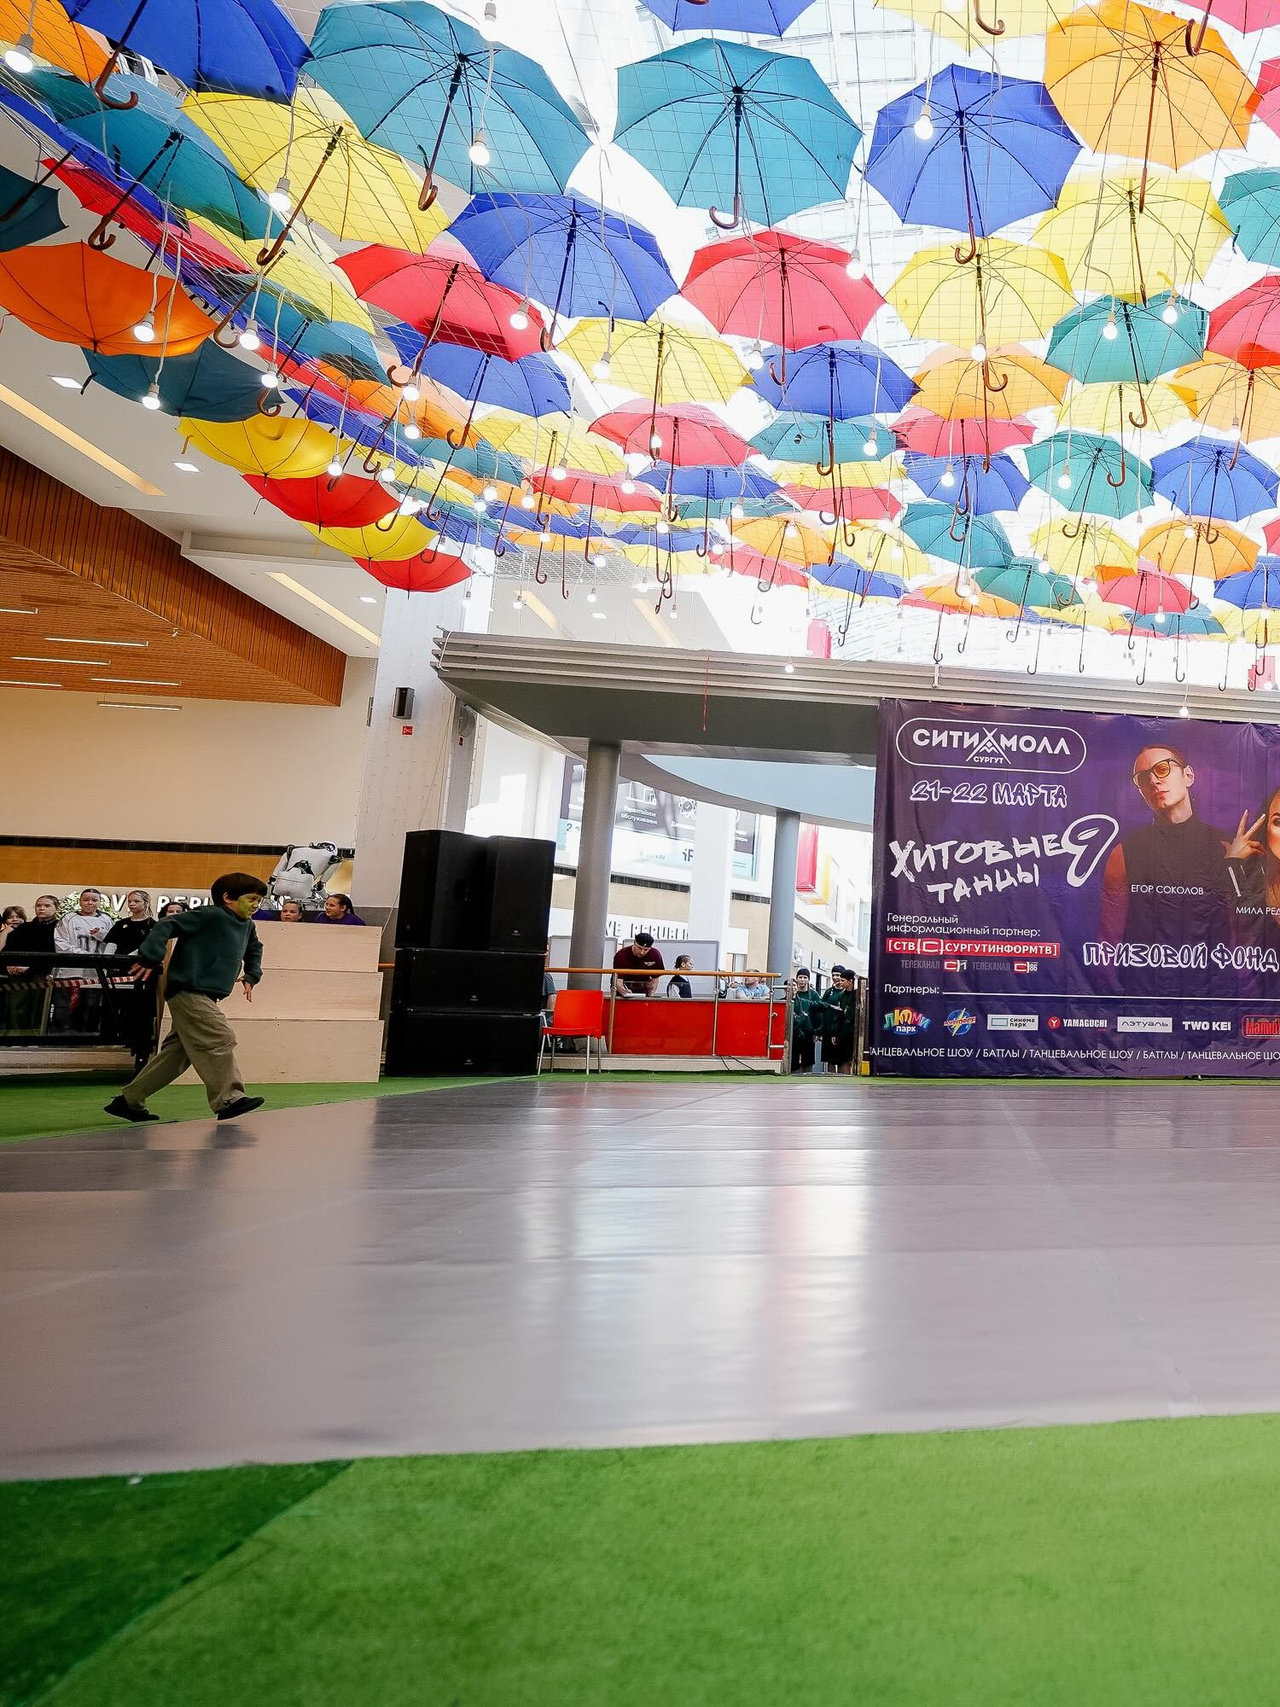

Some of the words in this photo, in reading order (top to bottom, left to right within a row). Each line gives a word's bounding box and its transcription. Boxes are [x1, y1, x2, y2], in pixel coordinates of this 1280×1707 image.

[973, 756, 1004, 764] СУРГУТ
[910, 780, 988, 804] 21-22
[992, 782, 1068, 808] МАРТА
[927, 863, 1040, 904] ТАНЦЫ
[1131, 885, 1153, 893] ЕГОР
[1155, 885, 1204, 895] СОКОЛОВ
[1235, 907, 1263, 915] МИЛА
[887, 913, 959, 924] Генеральный
[630, 923, 689, 940] REPUBLI
[886, 923, 990, 935] информационный
[992, 928, 1041, 938] партнер:
[1083, 941, 1208, 969] ПРИЗОВОЙ
[1211, 943, 1279, 973] ФОНД
[901, 959, 940, 969] ТЕЛЕКАНАЛ
[884, 984, 940, 995] Партнеры:
[883, 1006, 932, 1030] ЛЮМИ
[1063, 1018, 1108, 1028] YAMAGUCHI
[895, 1025, 916, 1034] парк
[1182, 1021, 1209, 1031] TWO
[1212, 1021, 1231, 1031] KEI
[869, 1047, 945, 1059] ТАНЦЕВАЛЬНОЕ
[947, 1048, 973, 1058] ШОУ
[982, 1048, 1020, 1058] БАТТЛЫ
[1029, 1049, 1106, 1060] ТАНЦЕВАЛЬНОЕ
[1109, 1050, 1134, 1059] ШОУ
[1143, 1050, 1179, 1059] БАТТЛЫ
[1187, 1051, 1264, 1061] ТАНЦЕВАЛЬНОЕ
